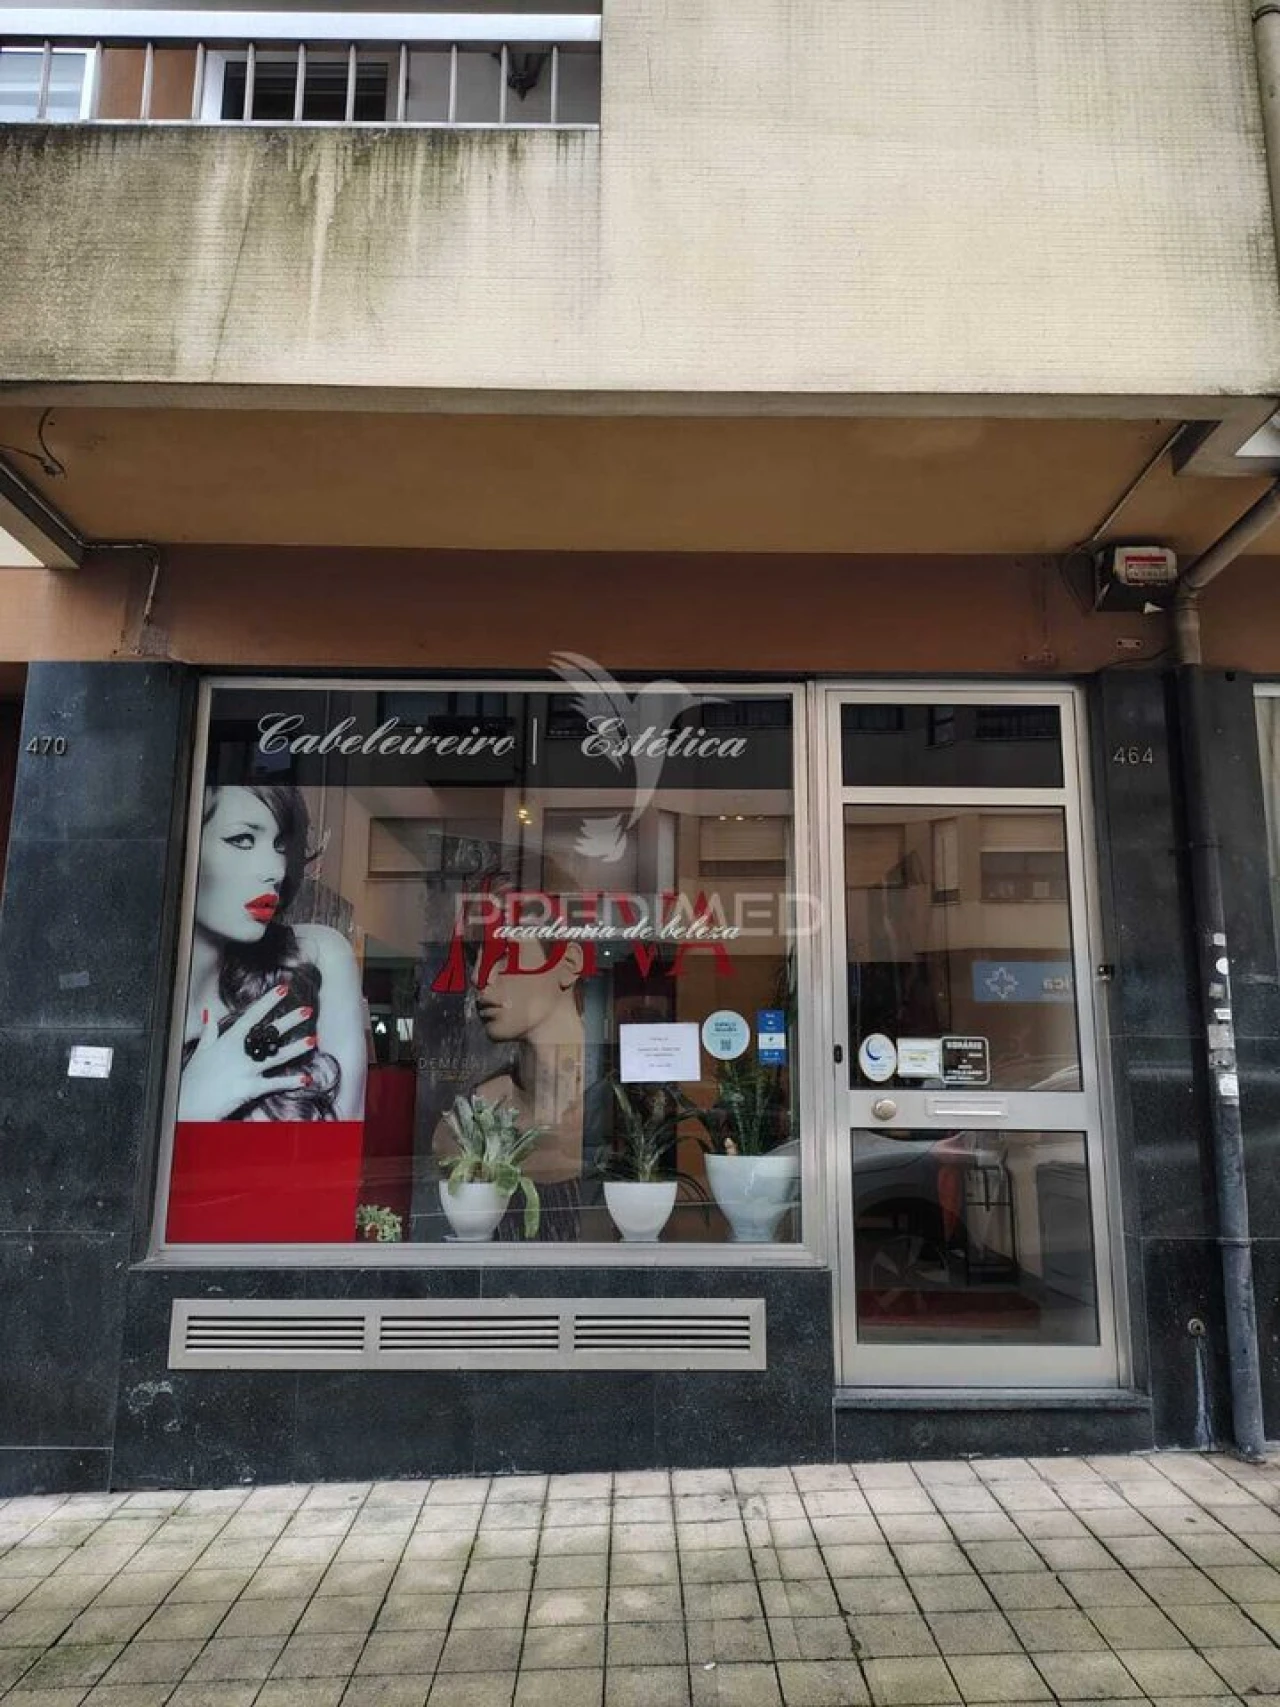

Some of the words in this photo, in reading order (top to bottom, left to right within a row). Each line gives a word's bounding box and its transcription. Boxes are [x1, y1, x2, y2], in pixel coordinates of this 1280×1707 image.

[25, 735, 67, 755] 470
[257, 712, 516, 757] Cabeleireiro
[580, 714, 748, 759] Estética
[1113, 746, 1153, 764] 464
[492, 915, 616, 940] academia
[621, 914, 656, 940] de
[659, 914, 741, 941] beleza
[498, 889, 738, 978] DIVA
